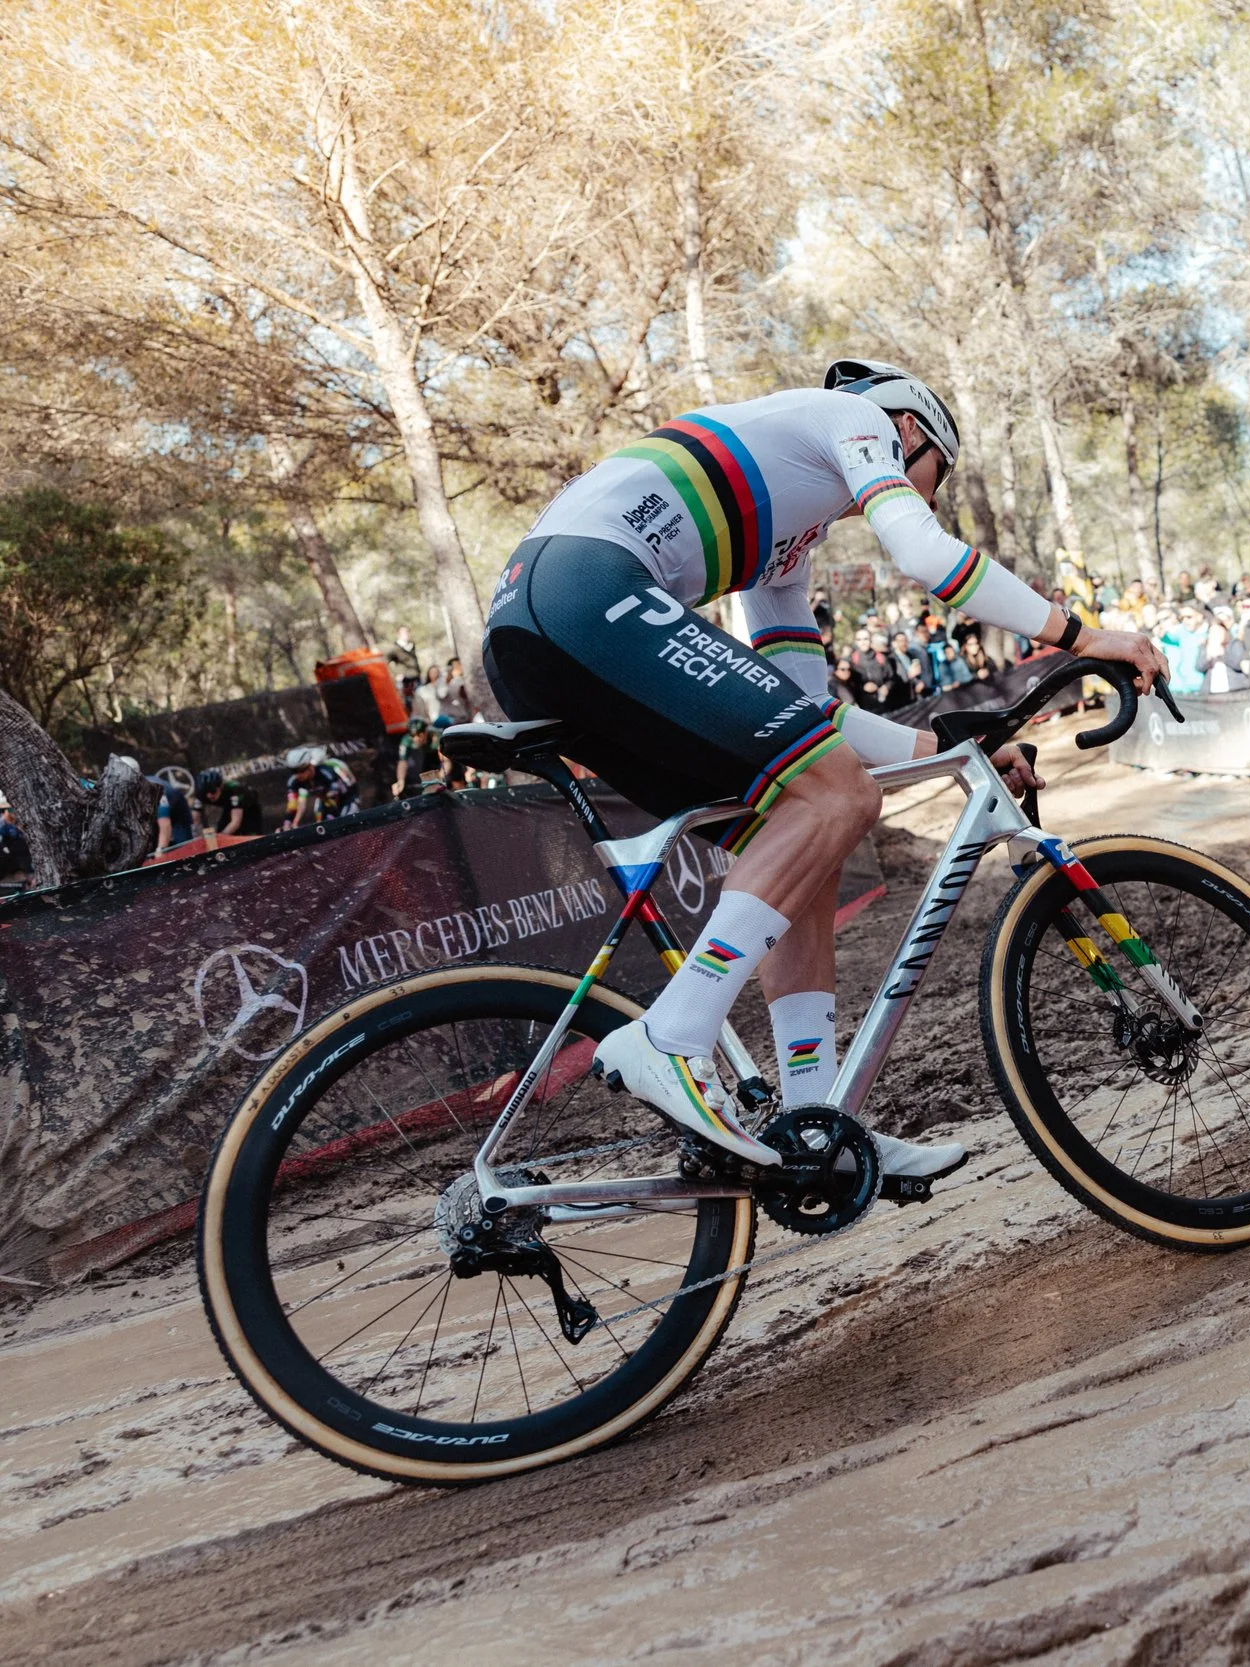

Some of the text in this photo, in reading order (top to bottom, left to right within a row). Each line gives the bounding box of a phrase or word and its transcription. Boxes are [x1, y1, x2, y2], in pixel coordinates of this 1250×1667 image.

[909, 384, 948, 433] CANYON
[858, 446, 874, 464] 1
[622, 492, 663, 528] Alpecin
[645, 500, 670, 524] SHAMPOO
[658, 513, 684, 537] PREMIER
[664, 527, 681, 543] TECH
[657, 638, 728, 687] TECH
[675, 622, 780, 694] PREMIER
[569, 780, 595, 824] CANYON
[337, 878, 608, 992] MERCEDES-BENZ VANS
[884, 841, 988, 1000] CANYON
[689, 964, 723, 983] ZWIFT
[389, 986, 406, 998] 33
[1016, 953, 1031, 1054] DURA-ACE
[270, 1032, 366, 1131] DURA-ACE
[790, 1065, 819, 1077] ZWIFT
[499, 1071, 538, 1130] SHIMANO
[1212, 1231, 1225, 1241] 33
[371, 1422, 510, 1446] DURA-ACE
